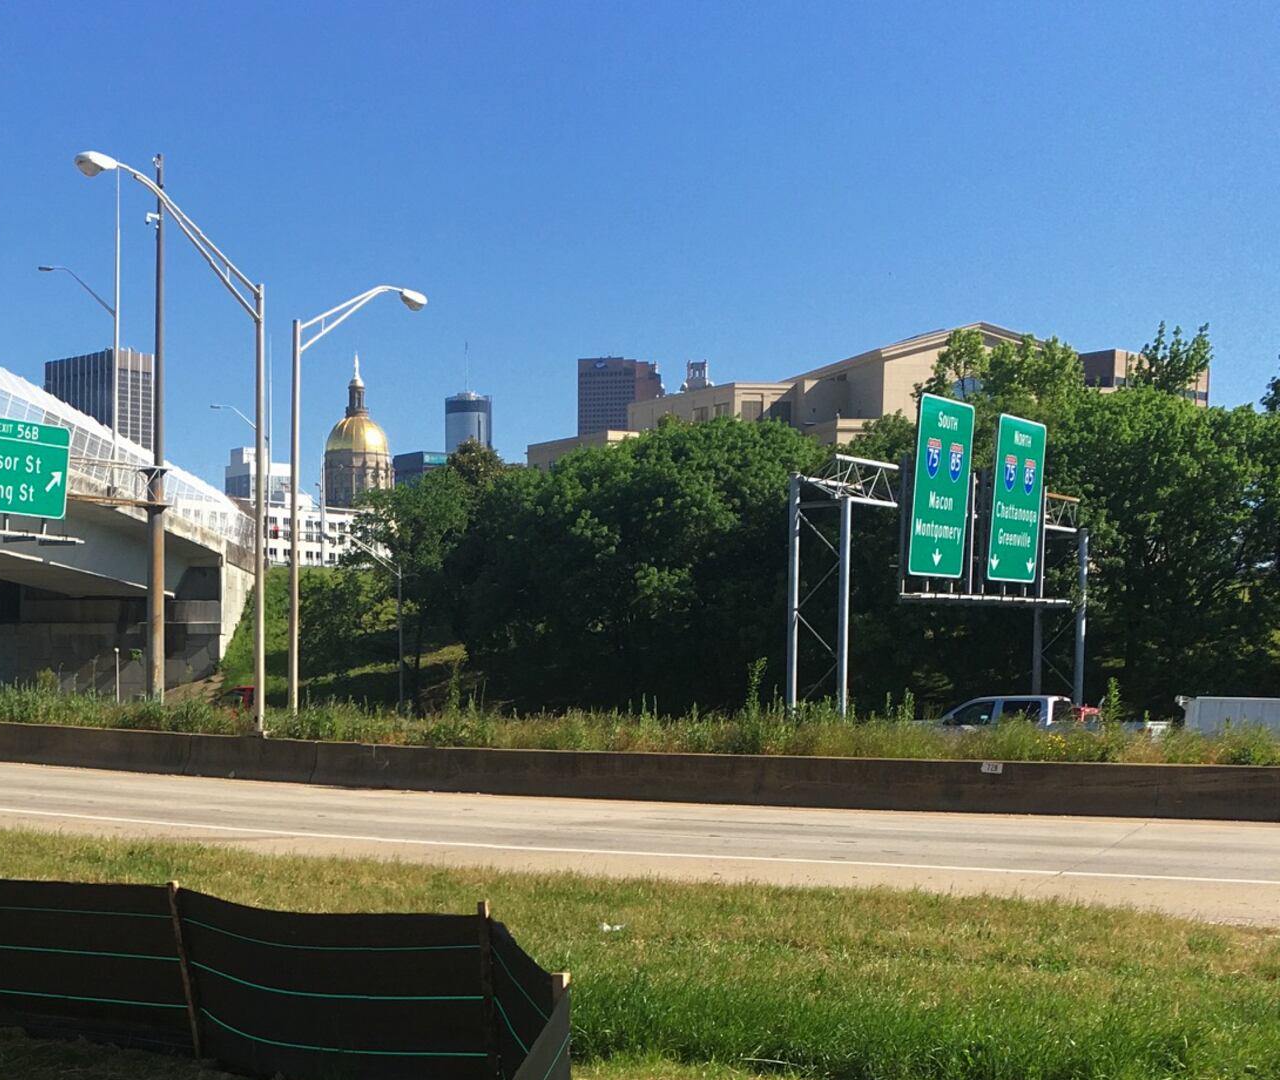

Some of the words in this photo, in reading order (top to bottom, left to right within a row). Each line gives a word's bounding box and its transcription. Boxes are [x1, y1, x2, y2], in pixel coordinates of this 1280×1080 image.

[17, 424, 39, 440] 56B
[25, 455, 42, 474] St
[928, 448, 939, 467] 75
[951, 453, 961, 471] 85
[1006, 464, 1016, 482] 75
[1024, 468, 1034, 485] 85
[19, 484, 35, 503] St
[929, 491, 953, 510] Macon
[996, 500, 1037, 527] Chattanooga
[914, 518, 962, 545] Montgomery
[997, 528, 1032, 548] Greenville
